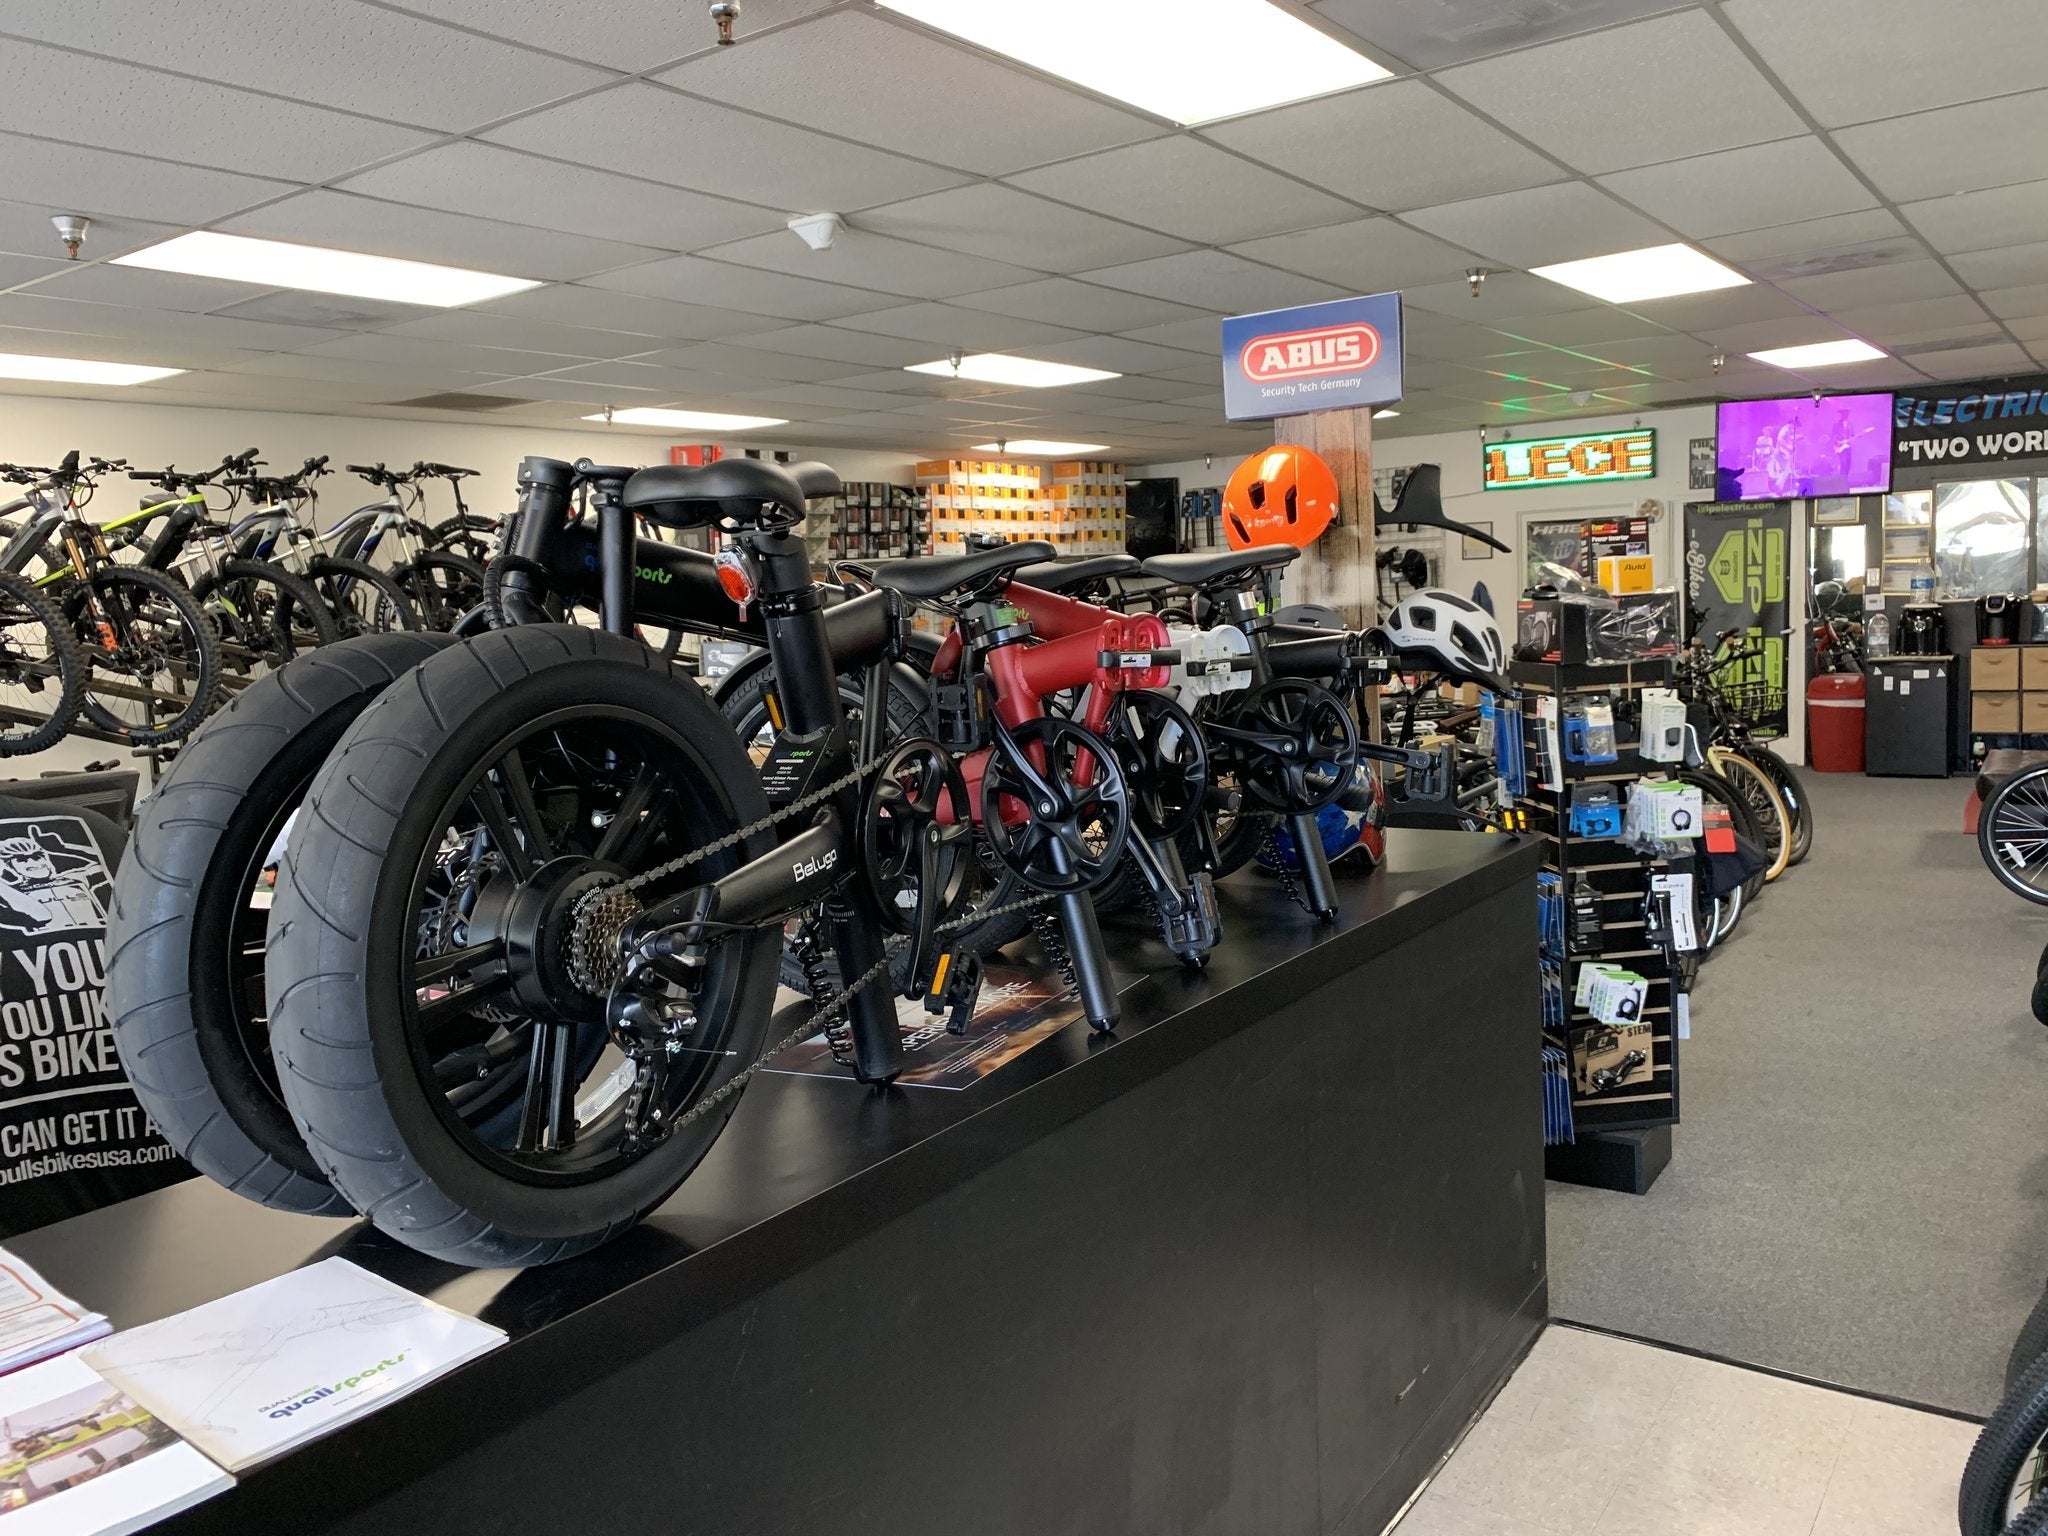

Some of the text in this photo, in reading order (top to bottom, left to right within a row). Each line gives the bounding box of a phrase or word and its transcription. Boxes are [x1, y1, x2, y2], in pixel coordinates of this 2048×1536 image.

[1260, 335, 1361, 372] ABUS
[1261, 377, 1362, 398] Security Tech Germany
[1976, 429, 2048, 456] WOR
[1624, 563, 1646, 571] Avid
[1747, 518, 1763, 615] IZIP
[792, 848, 838, 883] Beluga
[571, 886, 600, 916] SHIMANO
[0, 997, 55, 1041] OU
[1627, 1024, 1652, 1038] STEM
[1, 1117, 58, 1158] CAN
[62, 1109, 110, 1146] GET
[116, 1107, 138, 1140] IT
[269, 1353, 405, 1419] qualisports
